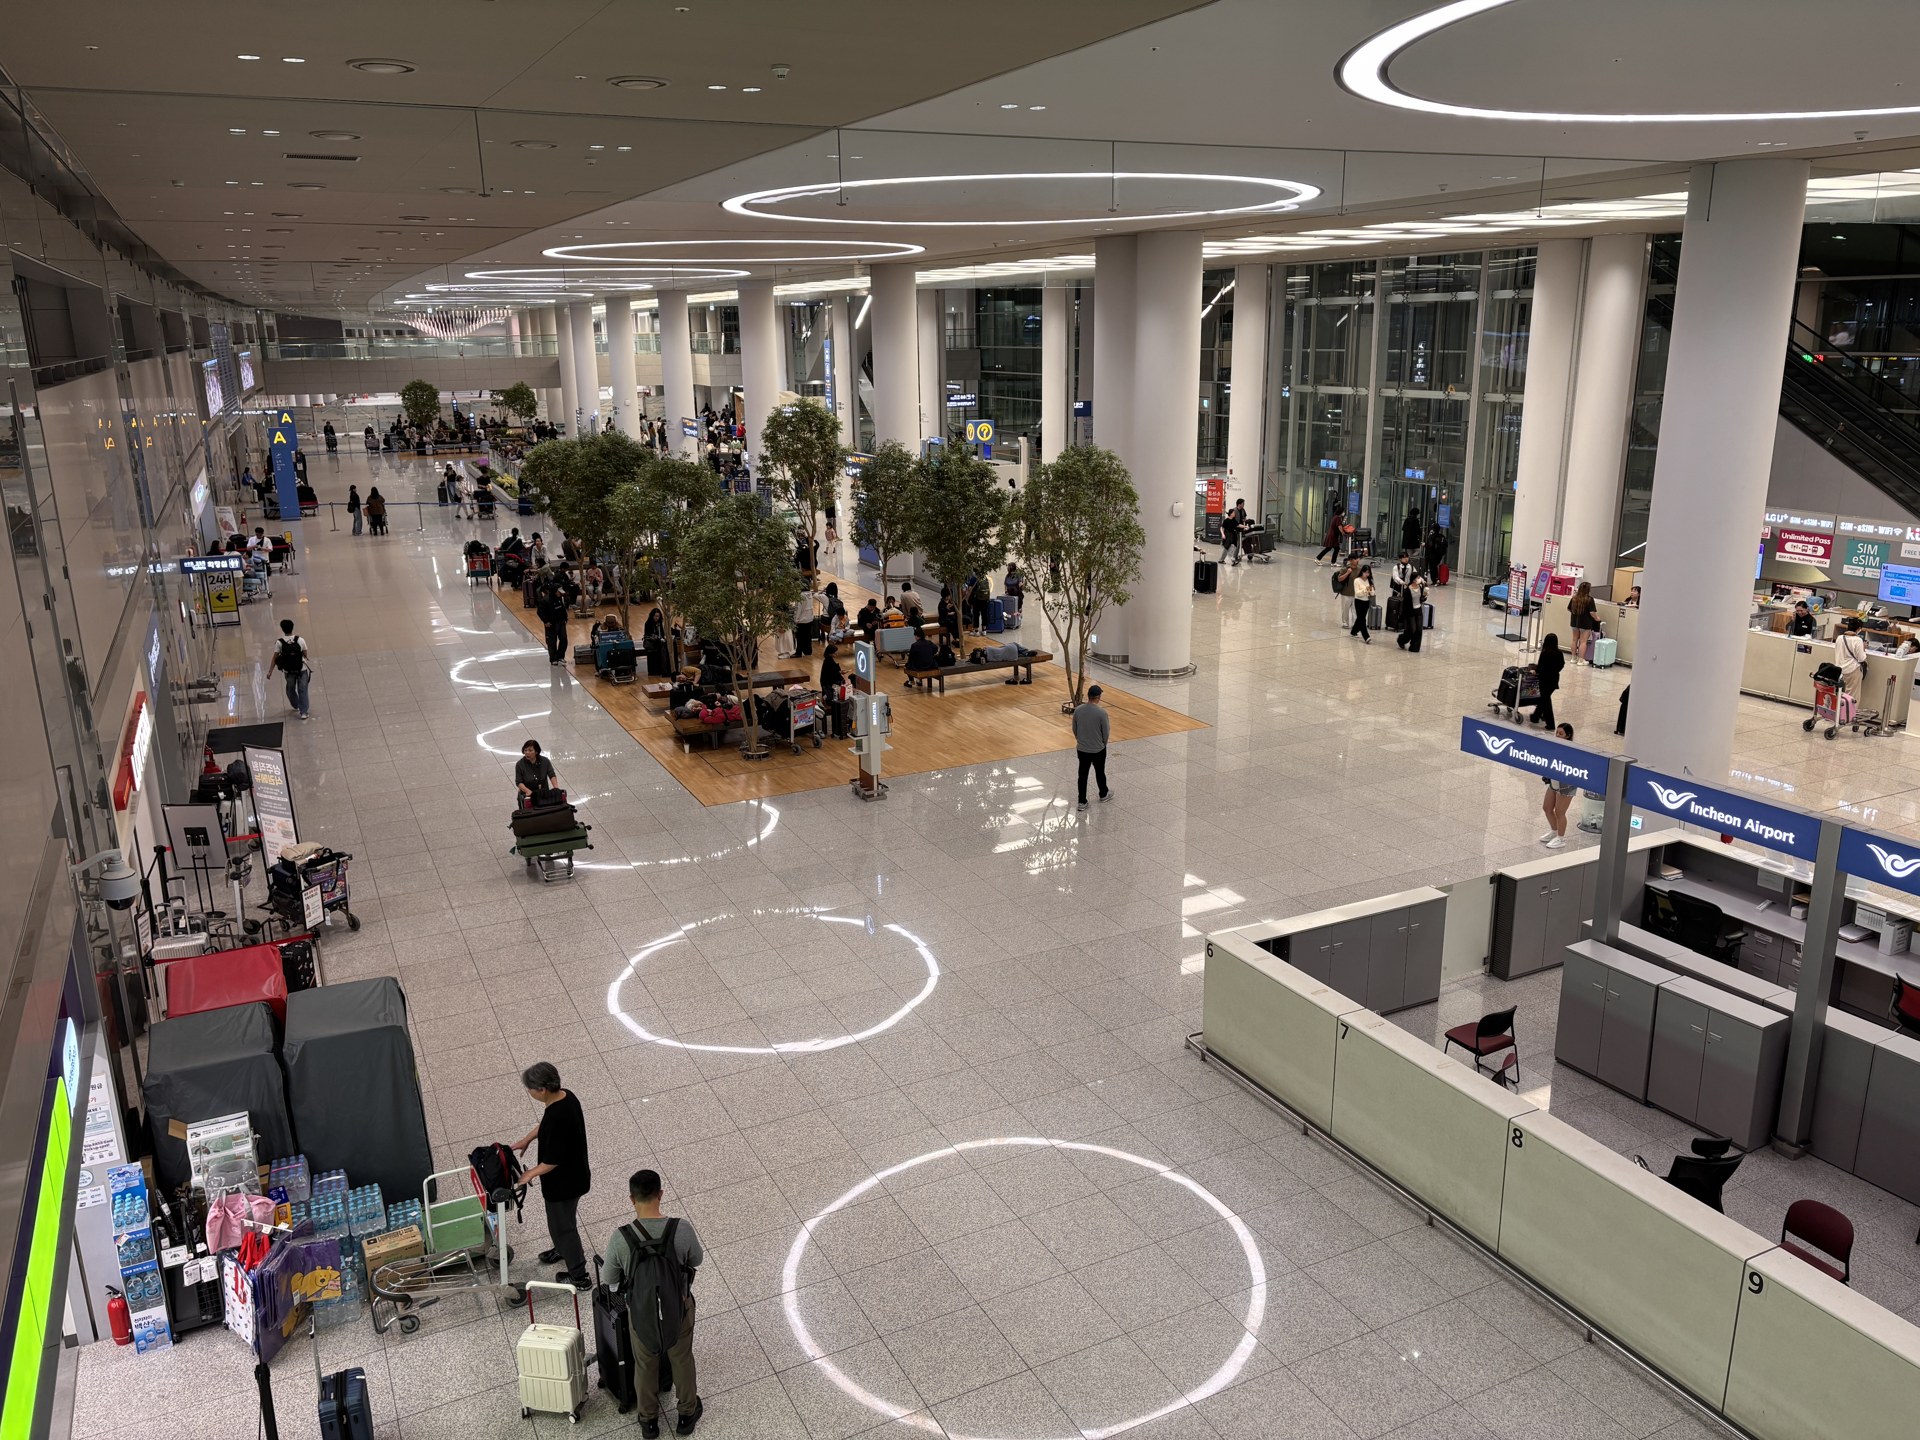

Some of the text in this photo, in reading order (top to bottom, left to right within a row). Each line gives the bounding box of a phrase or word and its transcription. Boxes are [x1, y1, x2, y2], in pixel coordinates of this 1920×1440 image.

[281, 413, 292, 423] A
[274, 431, 286, 444] A
[1765, 513, 1776, 522] LG
[1781, 532, 1831, 546] Unlimited Pass
[1857, 543, 1878, 556] SIM
[1852, 554, 1880, 567] eSIM
[208, 575, 232, 585] 24H
[1509, 746, 1589, 780] Incheon Airport
[1690, 801, 1796, 845] Incheon Airport
[1206, 943, 1214, 957] 6
[1340, 1022, 1349, 1039] 7
[1511, 1127, 1523, 1148] 8
[1748, 1271, 1763, 1294] 9
